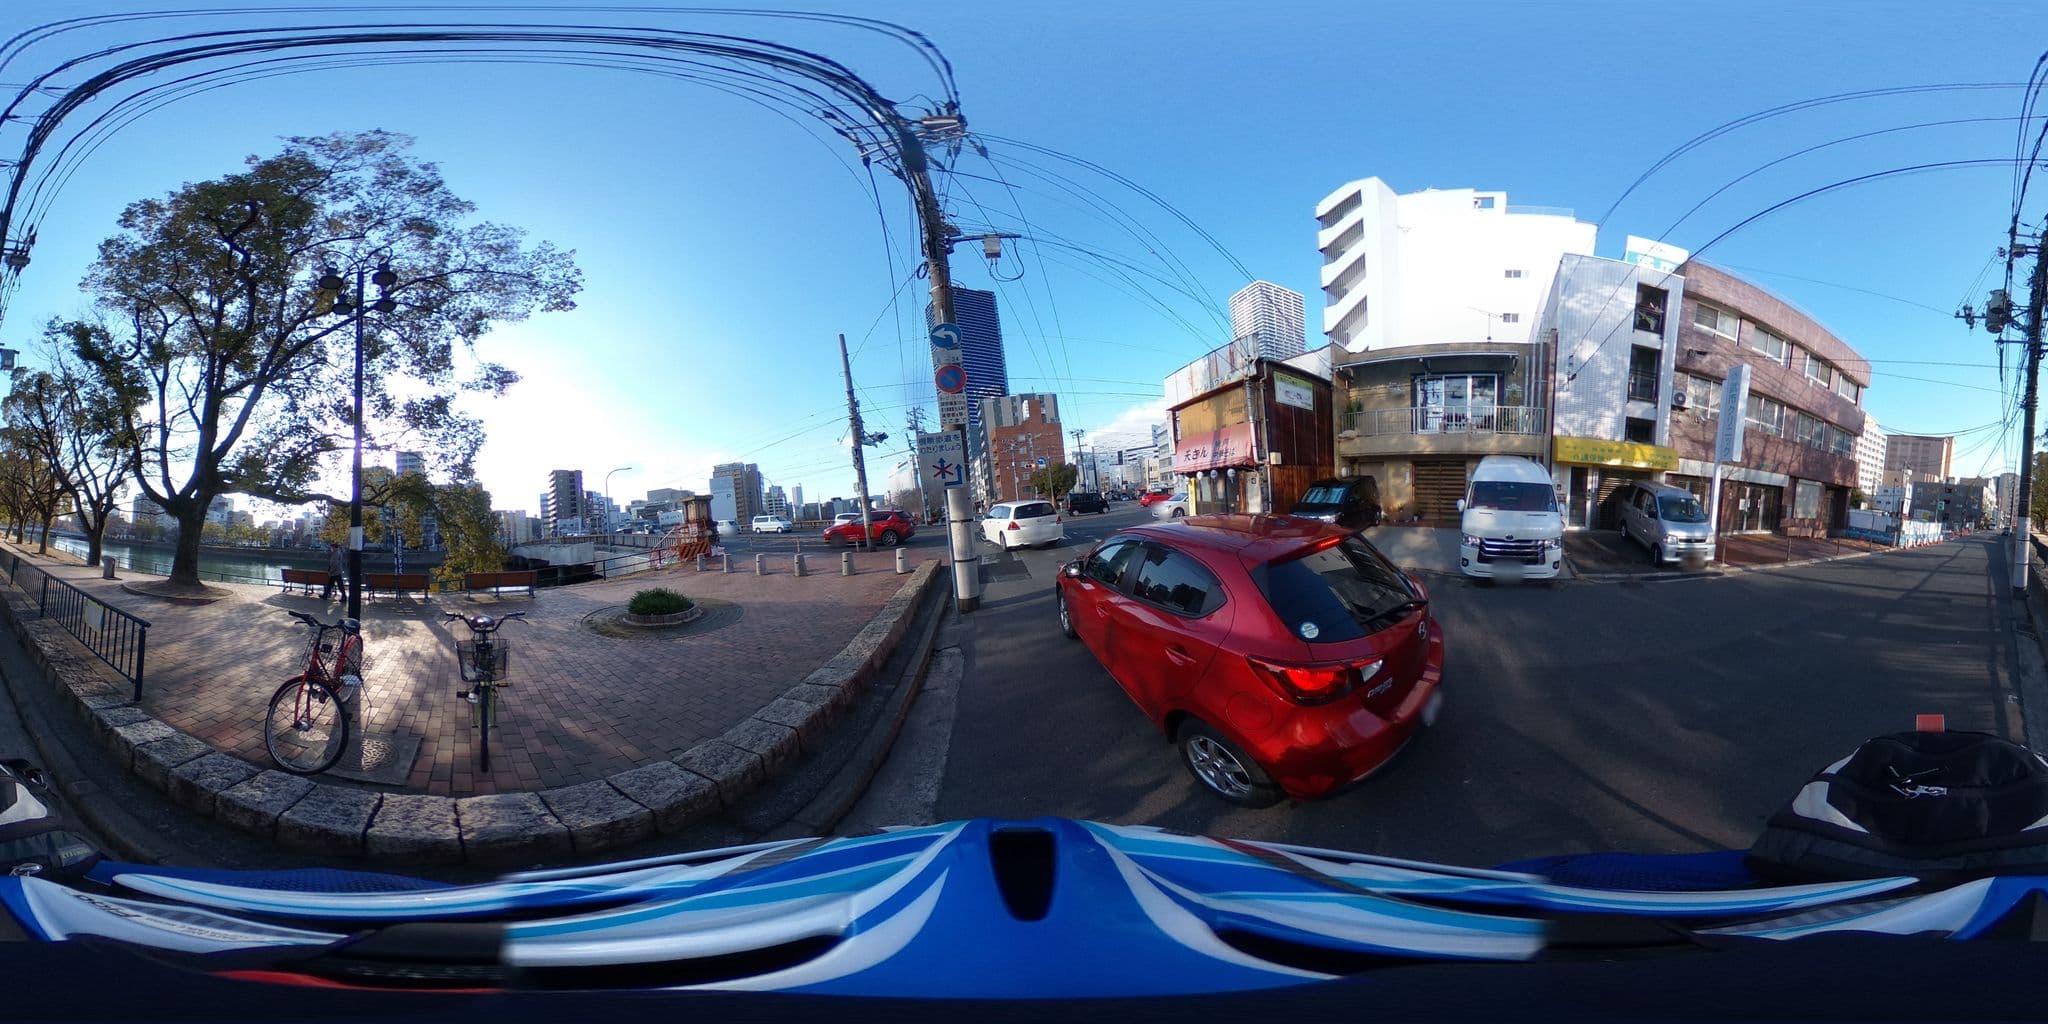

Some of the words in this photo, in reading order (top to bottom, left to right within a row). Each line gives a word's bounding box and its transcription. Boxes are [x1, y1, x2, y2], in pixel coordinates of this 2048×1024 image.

[920, 443, 962, 454] わたりましょう
